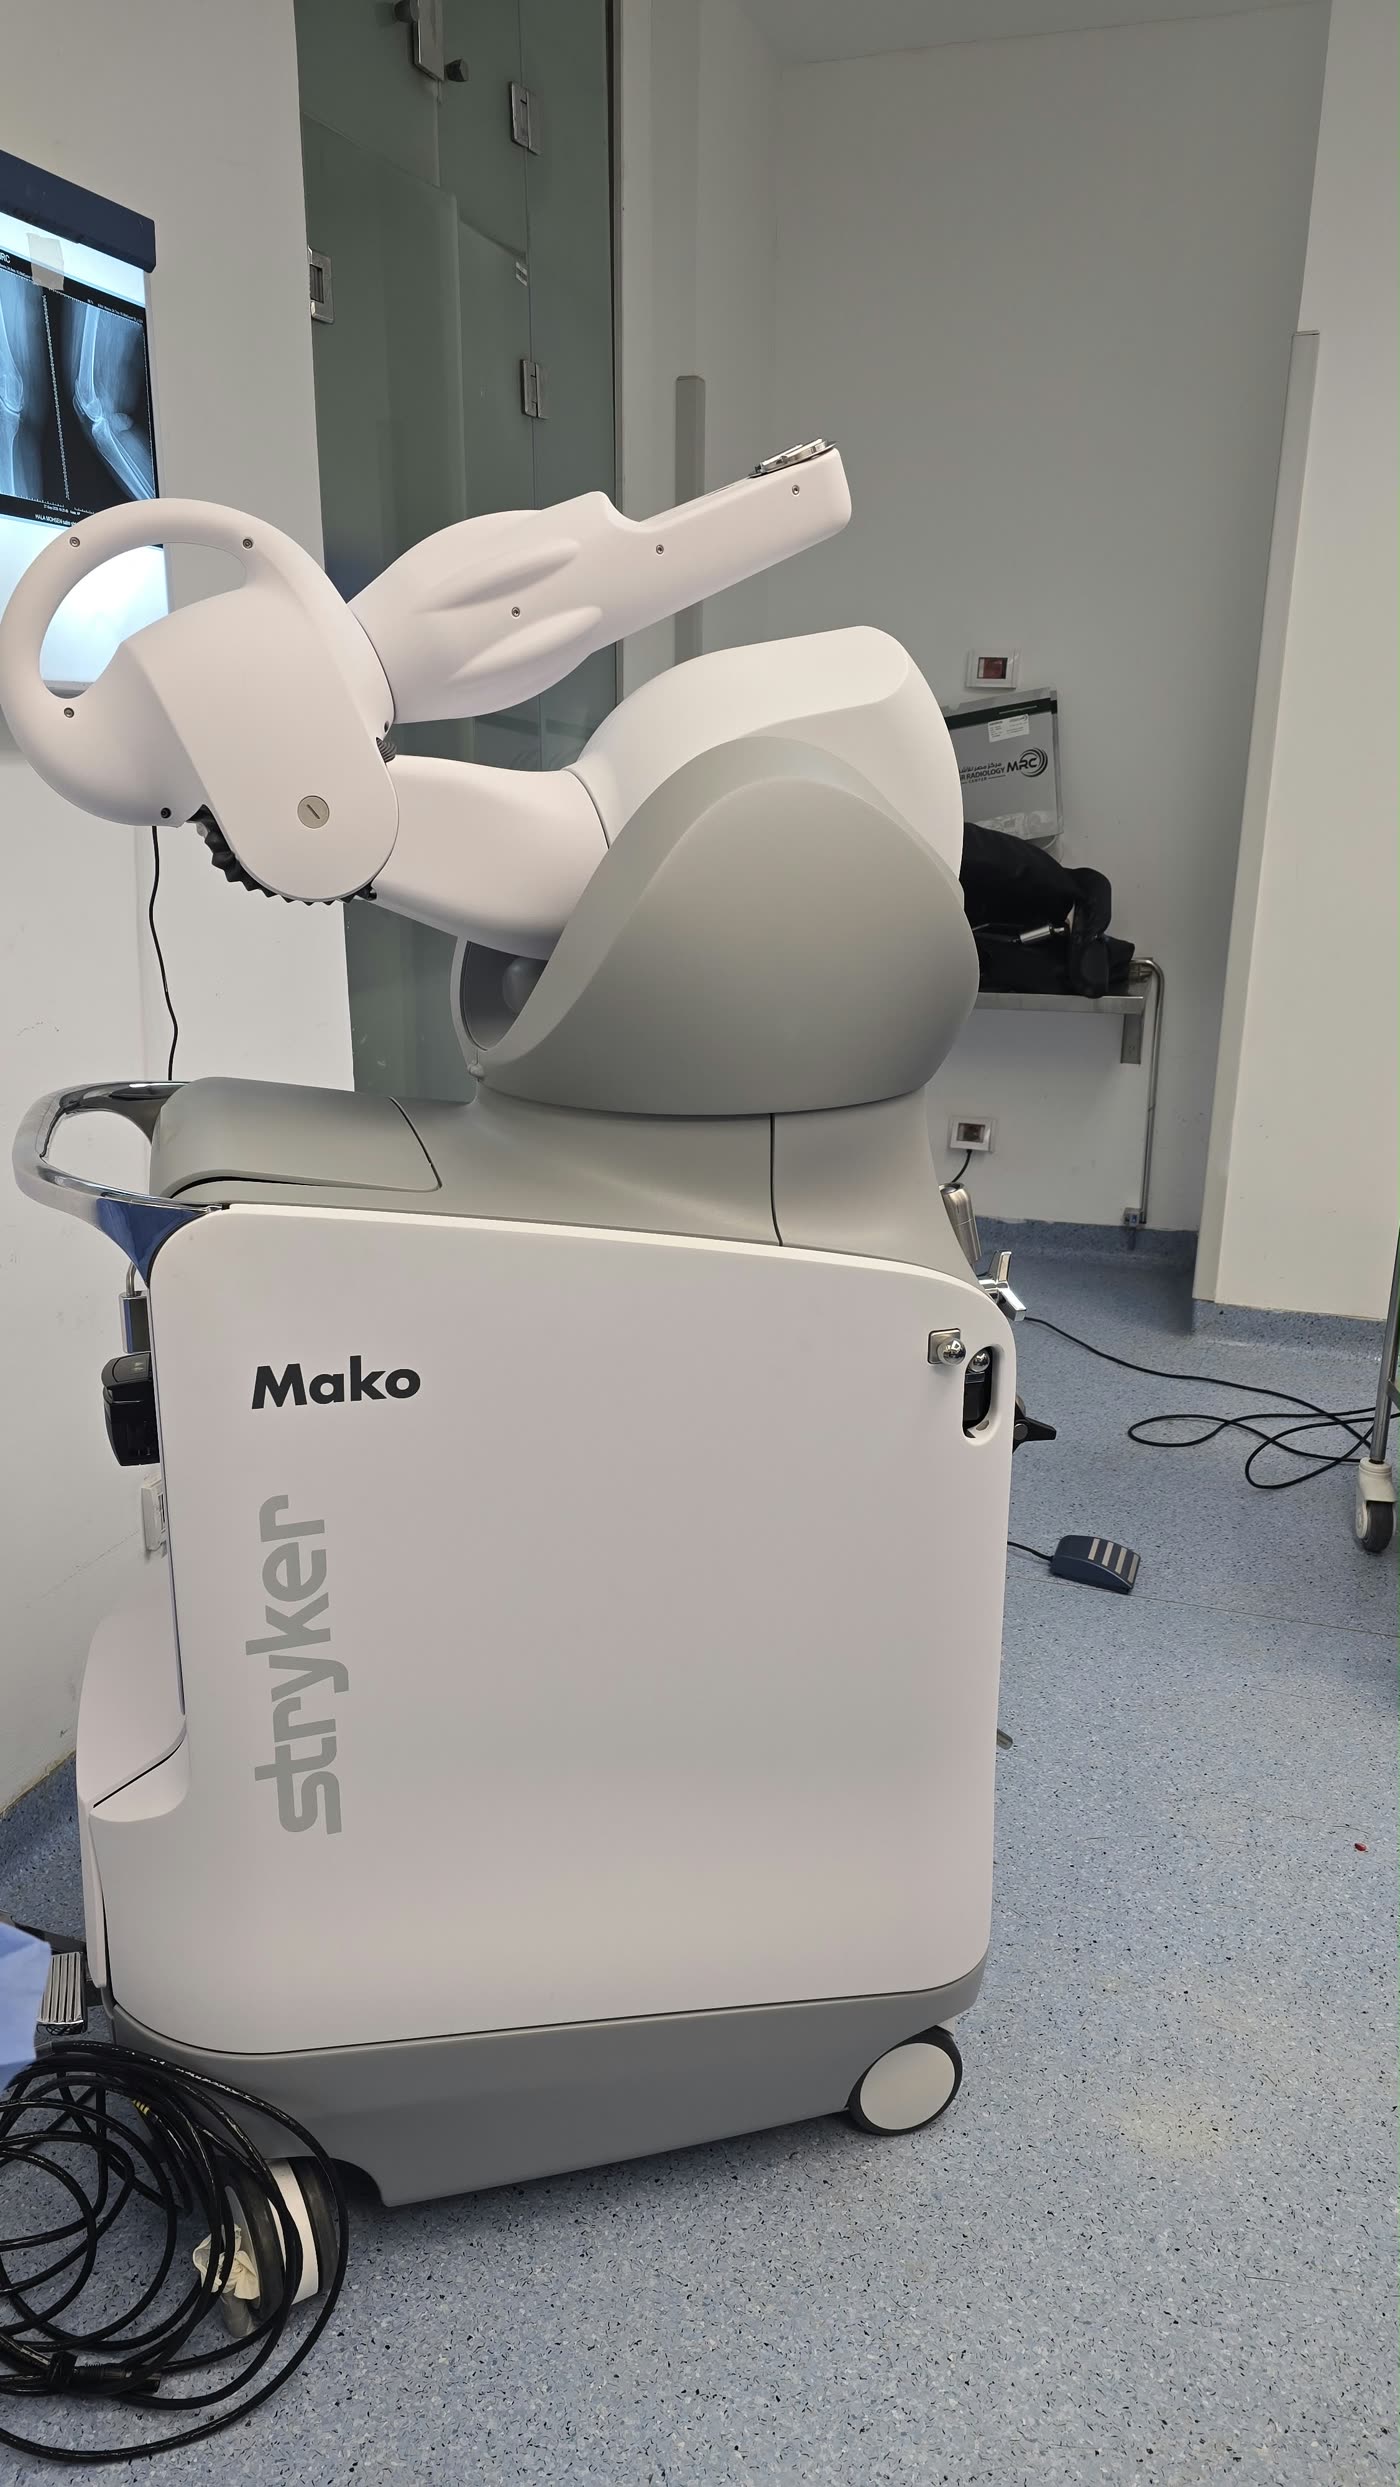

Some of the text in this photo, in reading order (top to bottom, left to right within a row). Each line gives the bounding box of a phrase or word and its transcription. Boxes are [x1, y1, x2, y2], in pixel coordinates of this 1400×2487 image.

[0, 252, 10, 264] RC
[1007, 757, 1038, 773] MRC
[967, 767, 1005, 780] RADIOLOGY
[252, 1355, 421, 1409] Mako
[245, 1494, 349, 1835] stryker
